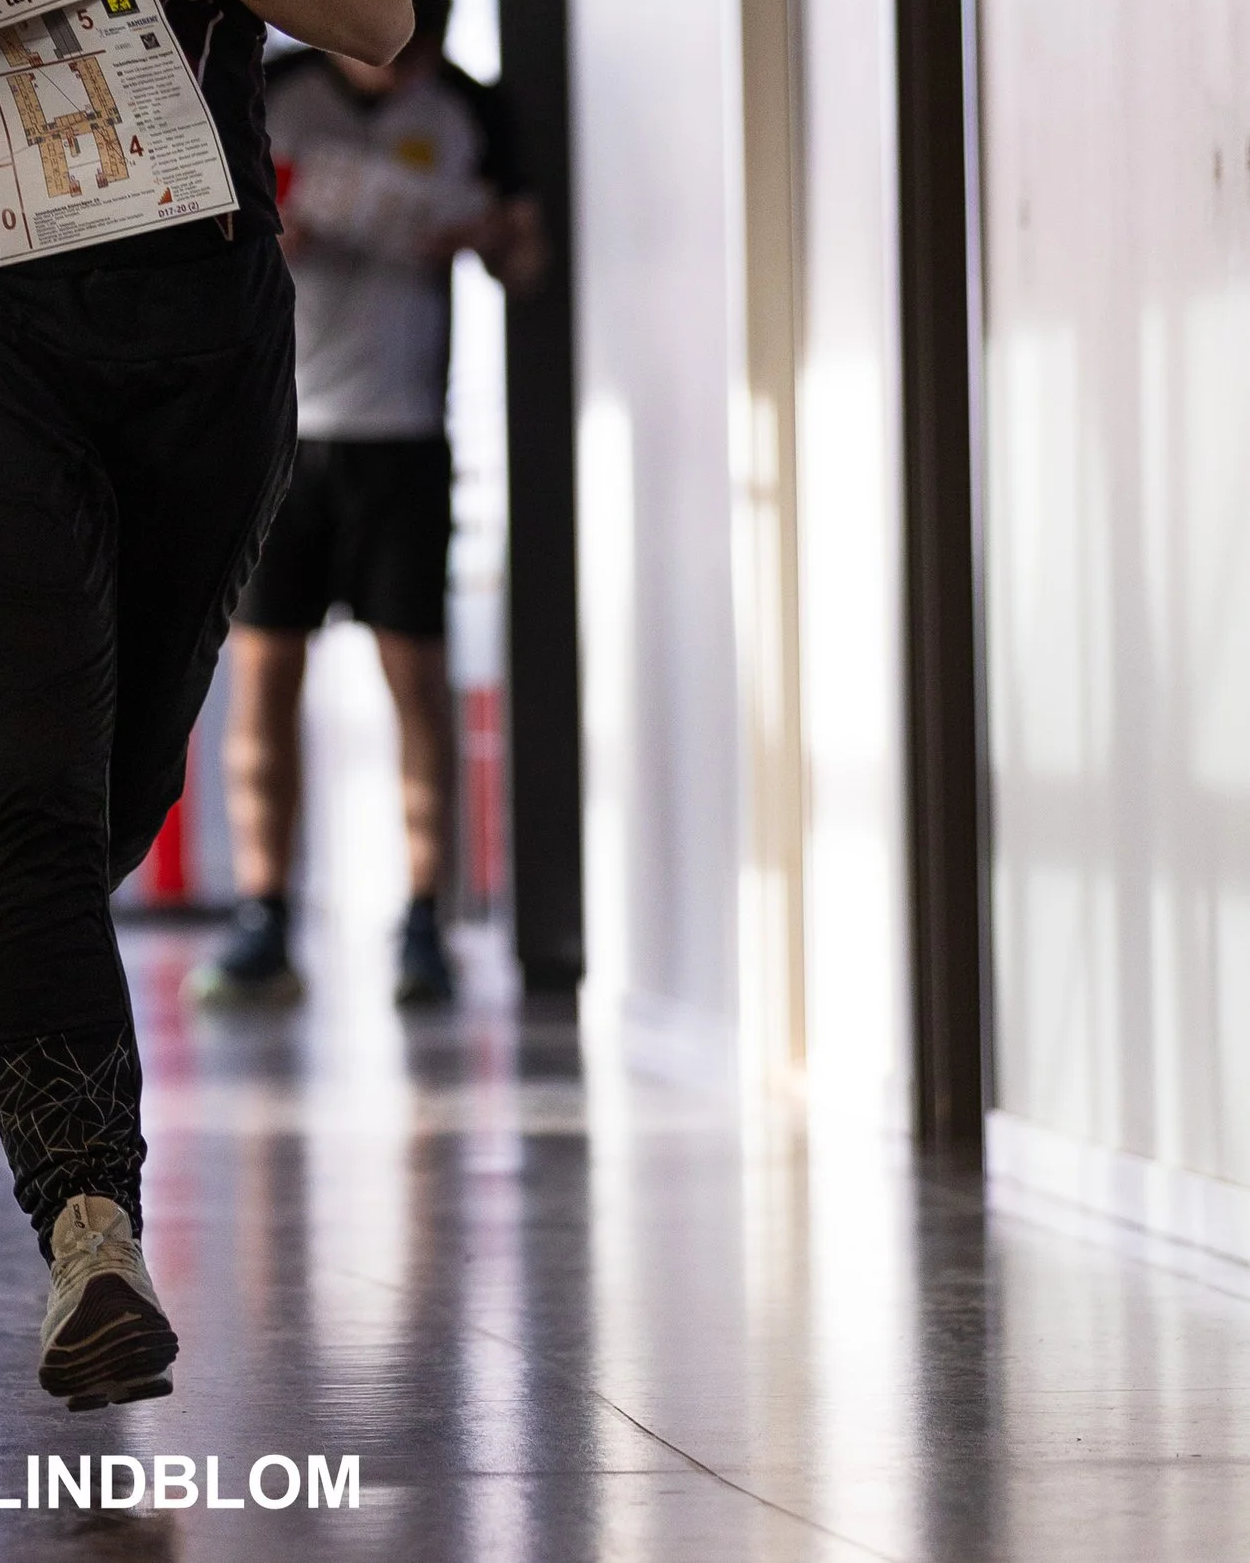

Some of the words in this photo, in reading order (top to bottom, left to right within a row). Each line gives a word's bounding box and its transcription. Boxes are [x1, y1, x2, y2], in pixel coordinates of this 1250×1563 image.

[77, 9, 94, 30] 5
[129, 134, 145, 157] 4
[1, 208, 17, 230] 0
[158, 204, 187, 218] D17-20
[187, 201, 200, 213] (2)
